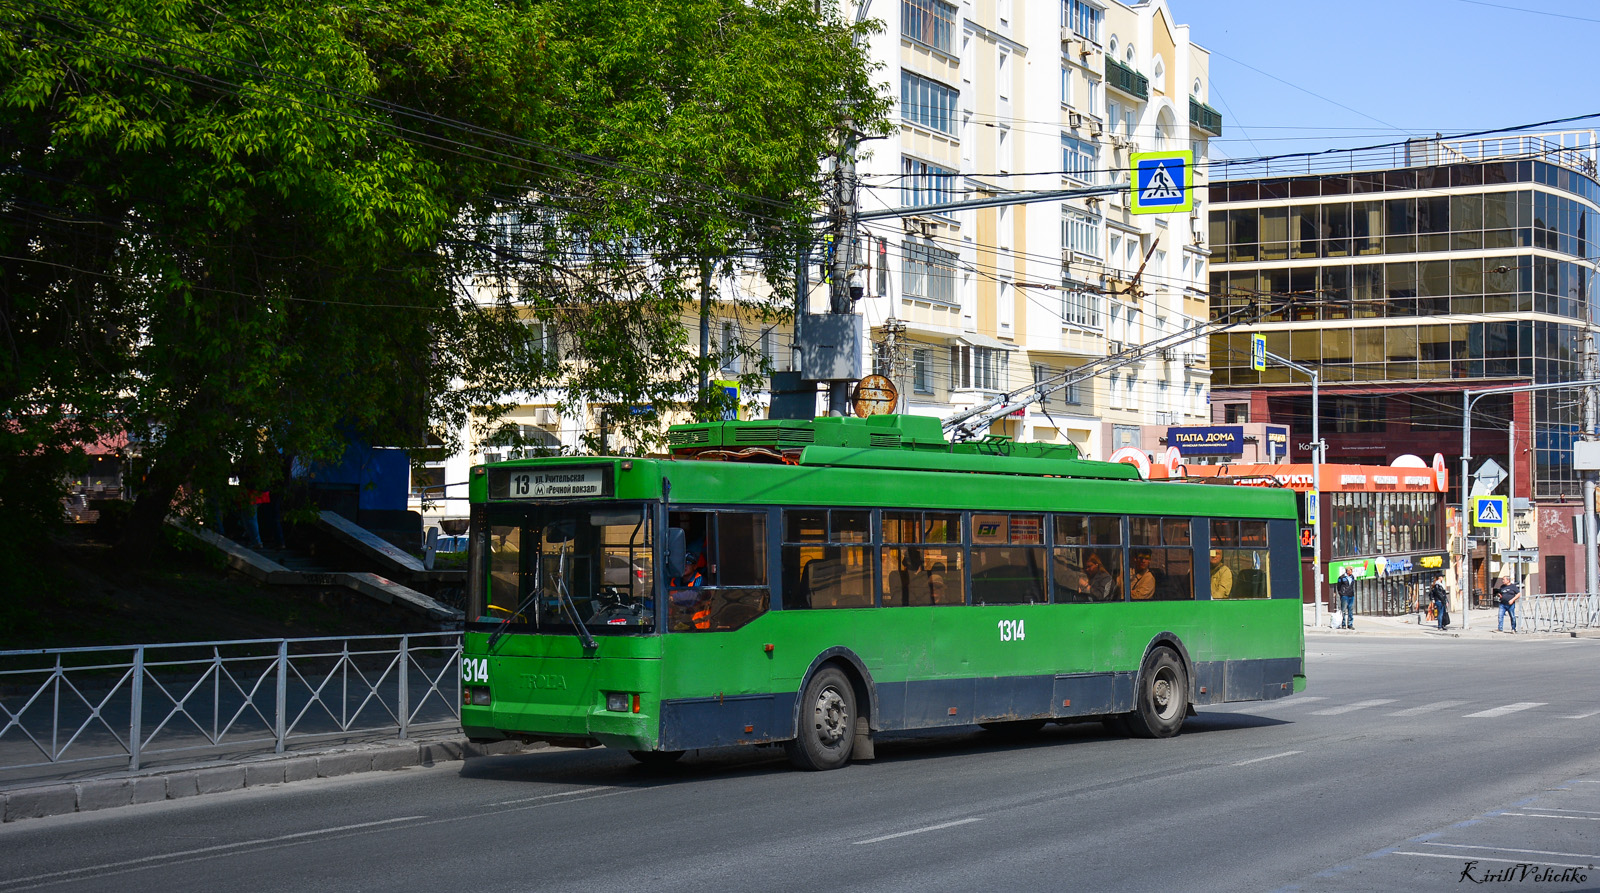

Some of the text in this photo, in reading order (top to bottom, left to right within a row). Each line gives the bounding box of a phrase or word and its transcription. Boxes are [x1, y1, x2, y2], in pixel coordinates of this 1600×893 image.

[1176, 432, 1235, 442] ПАПА ДОМА
[514, 474, 530, 495] 13
[535, 473, 585, 483] ул. Учительская
[997, 619, 1025, 641] 1314
